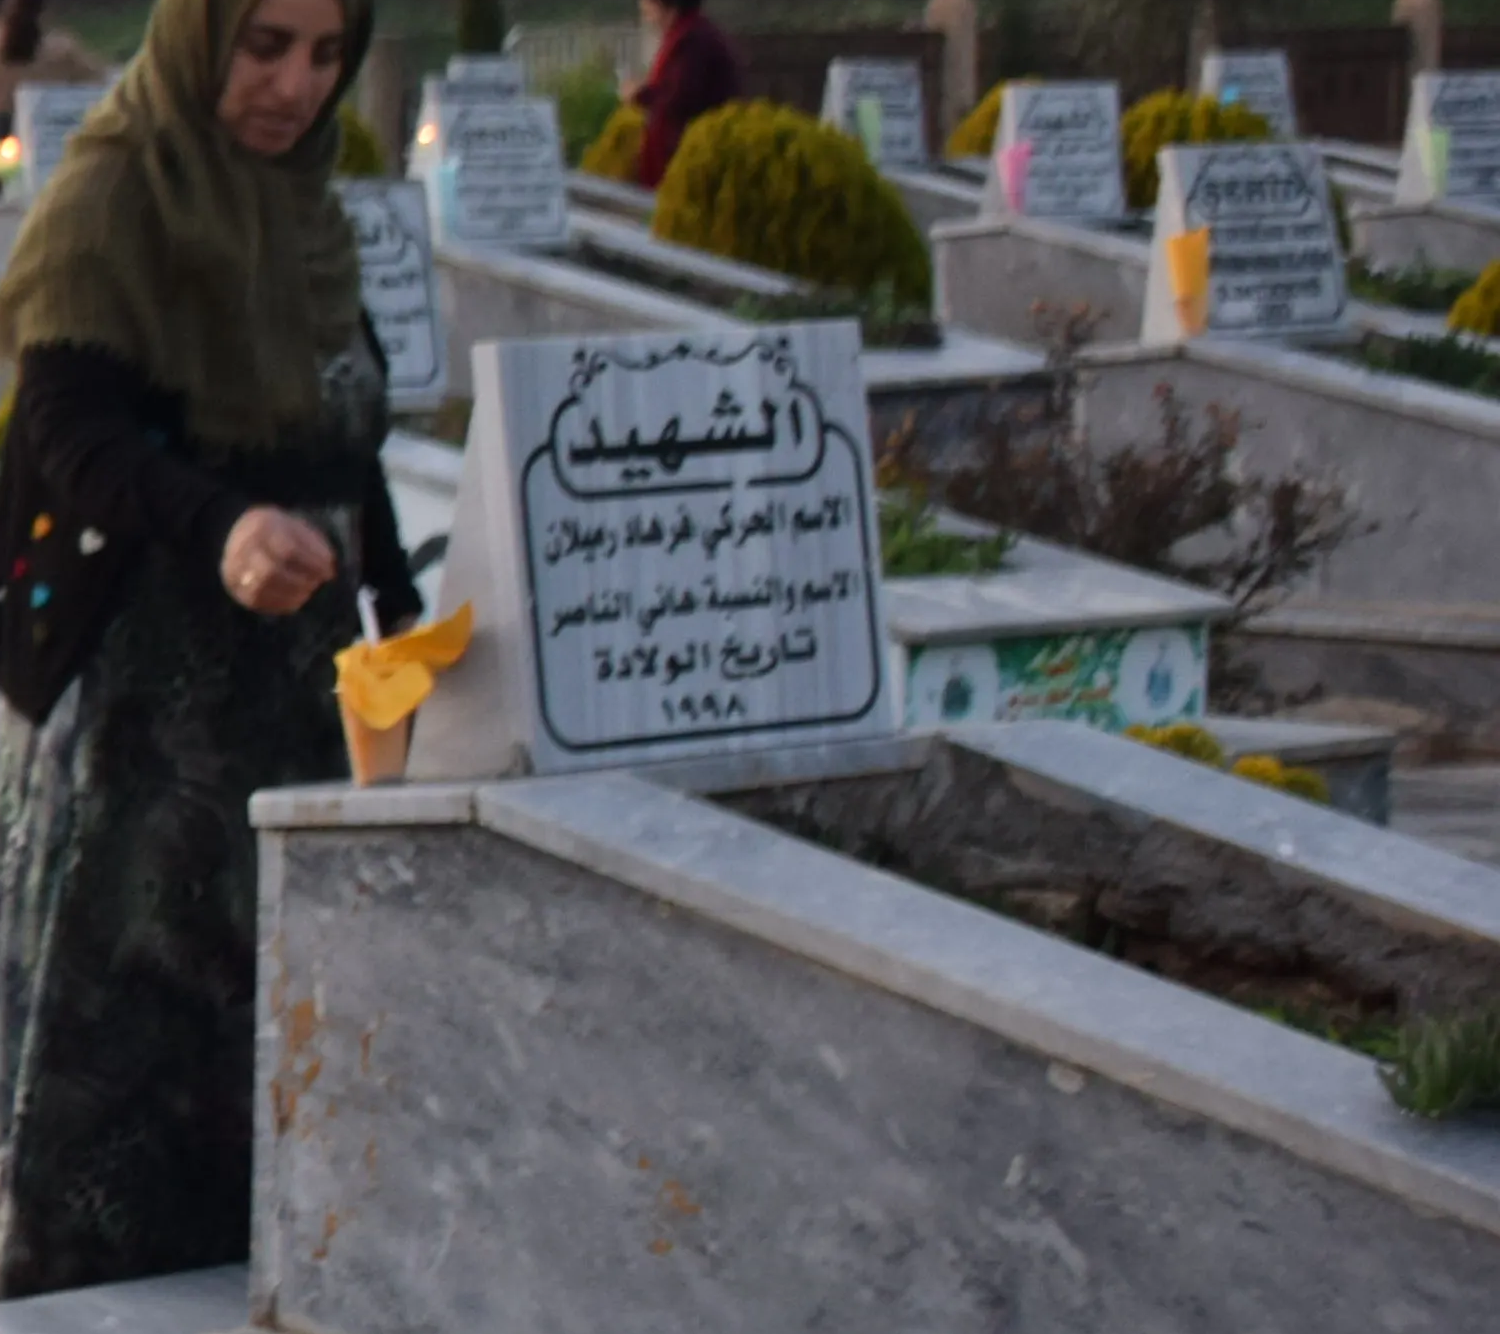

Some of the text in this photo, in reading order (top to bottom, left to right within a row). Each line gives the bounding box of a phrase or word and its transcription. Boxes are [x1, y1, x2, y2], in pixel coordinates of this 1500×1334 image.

[569, 389, 803, 480] الشهيد
[702, 498, 786, 560] الحركي
[791, 498, 851, 545] الاسم
[701, 575, 796, 621] والنسبة
[802, 571, 859, 612] الاسم
[594, 628, 817, 686] تاريخ الولادة
